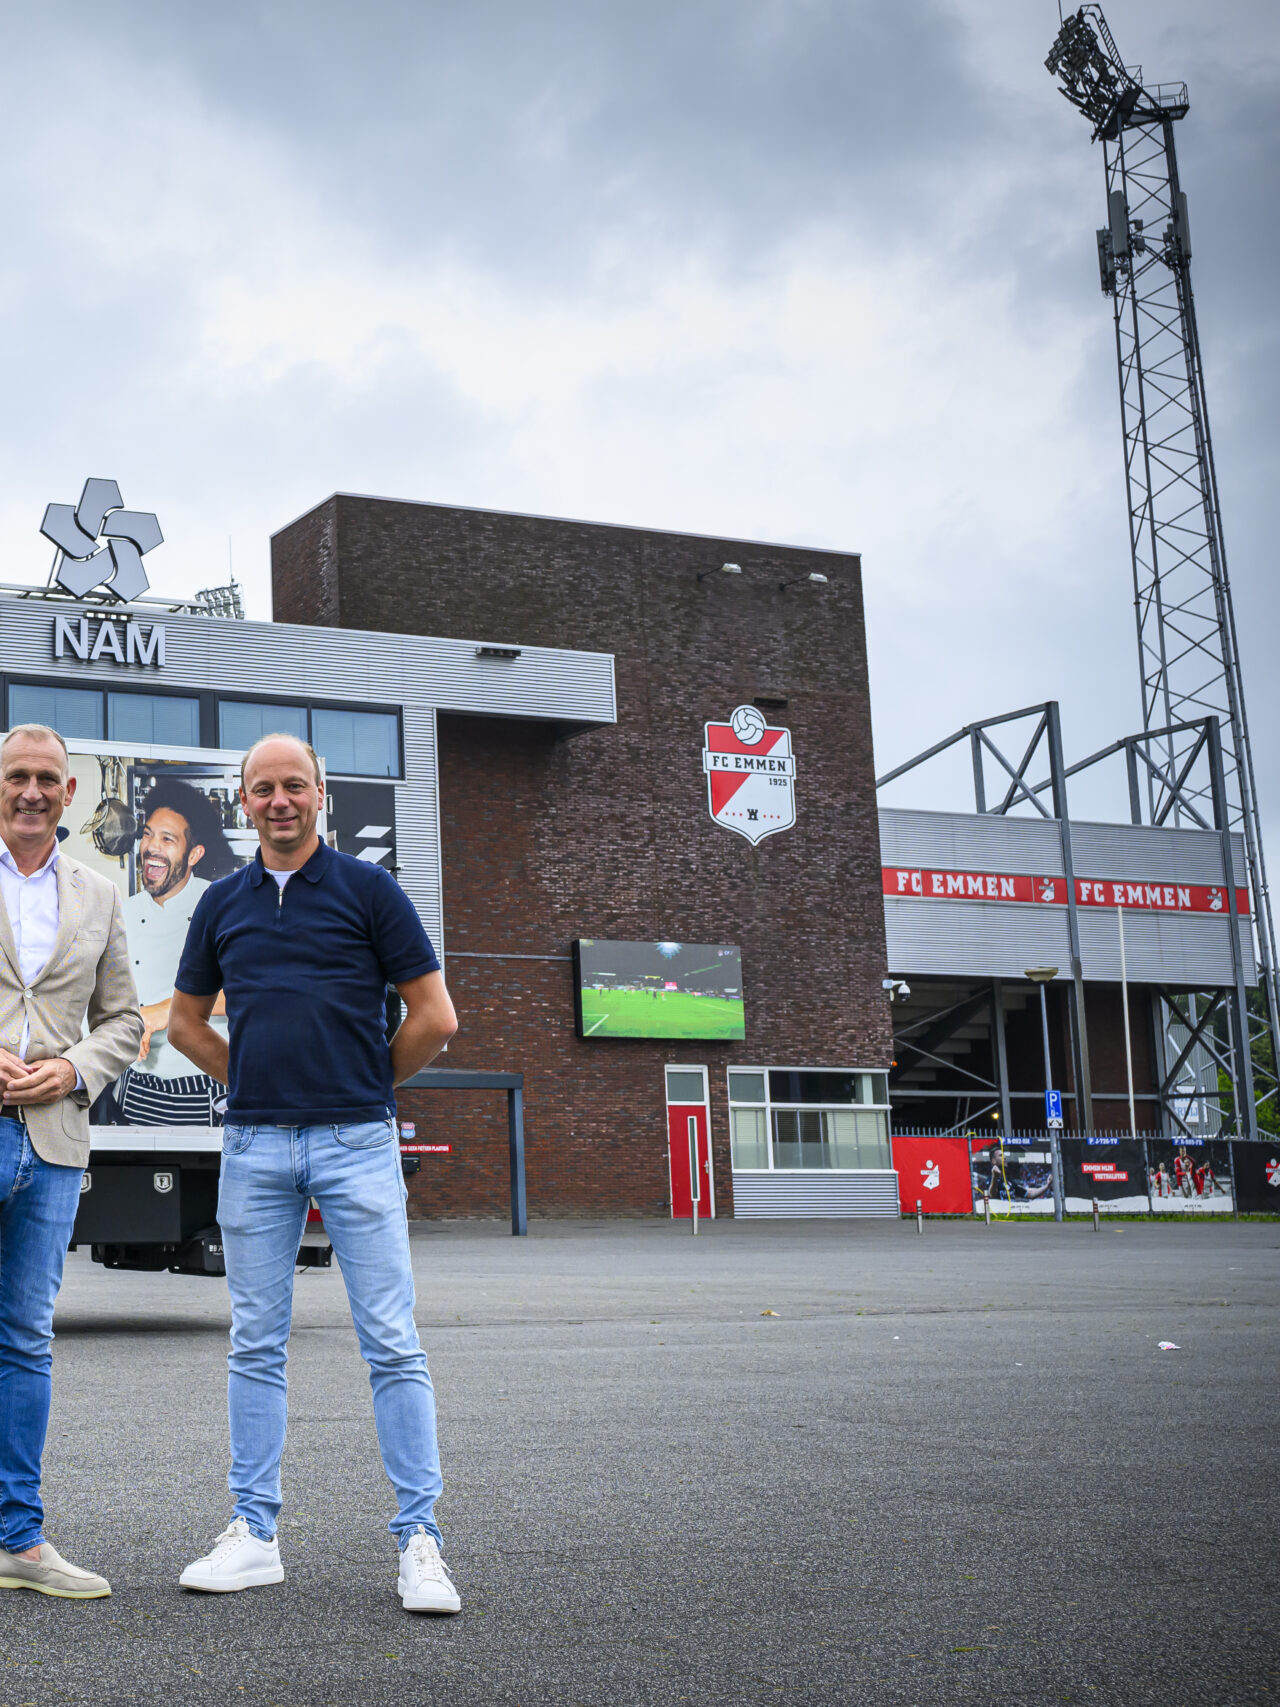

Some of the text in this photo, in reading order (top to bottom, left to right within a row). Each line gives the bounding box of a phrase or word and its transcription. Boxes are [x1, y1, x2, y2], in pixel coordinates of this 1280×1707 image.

[55, 615, 166, 667] NAM
[713, 755, 786, 772] FC EMMEN
[769, 777, 787, 786] 1925
[897, 871, 1015, 897] FC EMMEN
[1080, 882, 1191, 907] FC EMMEN
[1049, 1093, 1058, 1108] P
